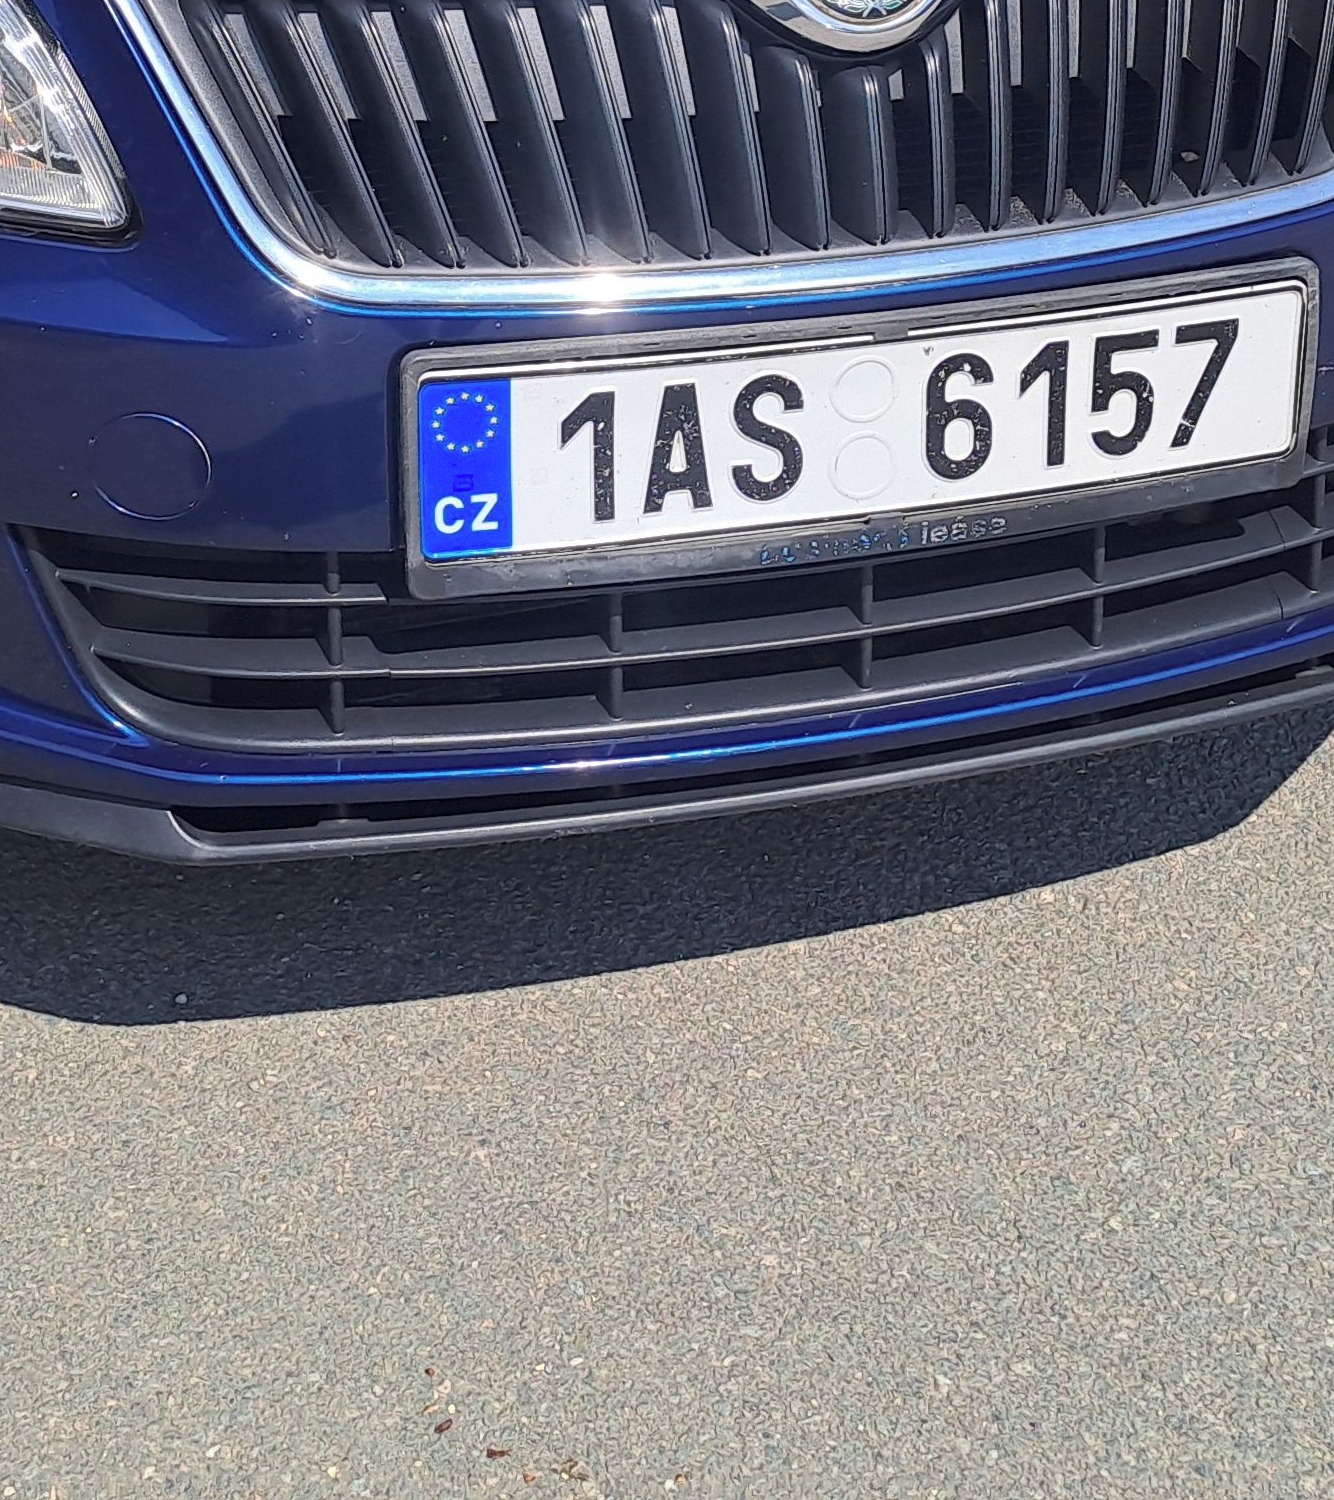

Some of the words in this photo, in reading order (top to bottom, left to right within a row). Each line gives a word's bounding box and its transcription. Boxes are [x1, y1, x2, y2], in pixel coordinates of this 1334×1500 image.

[560, 373, 805, 522] 1AS
[925, 317, 1240, 480] 6157
[433, 492, 499, 534] CZ
